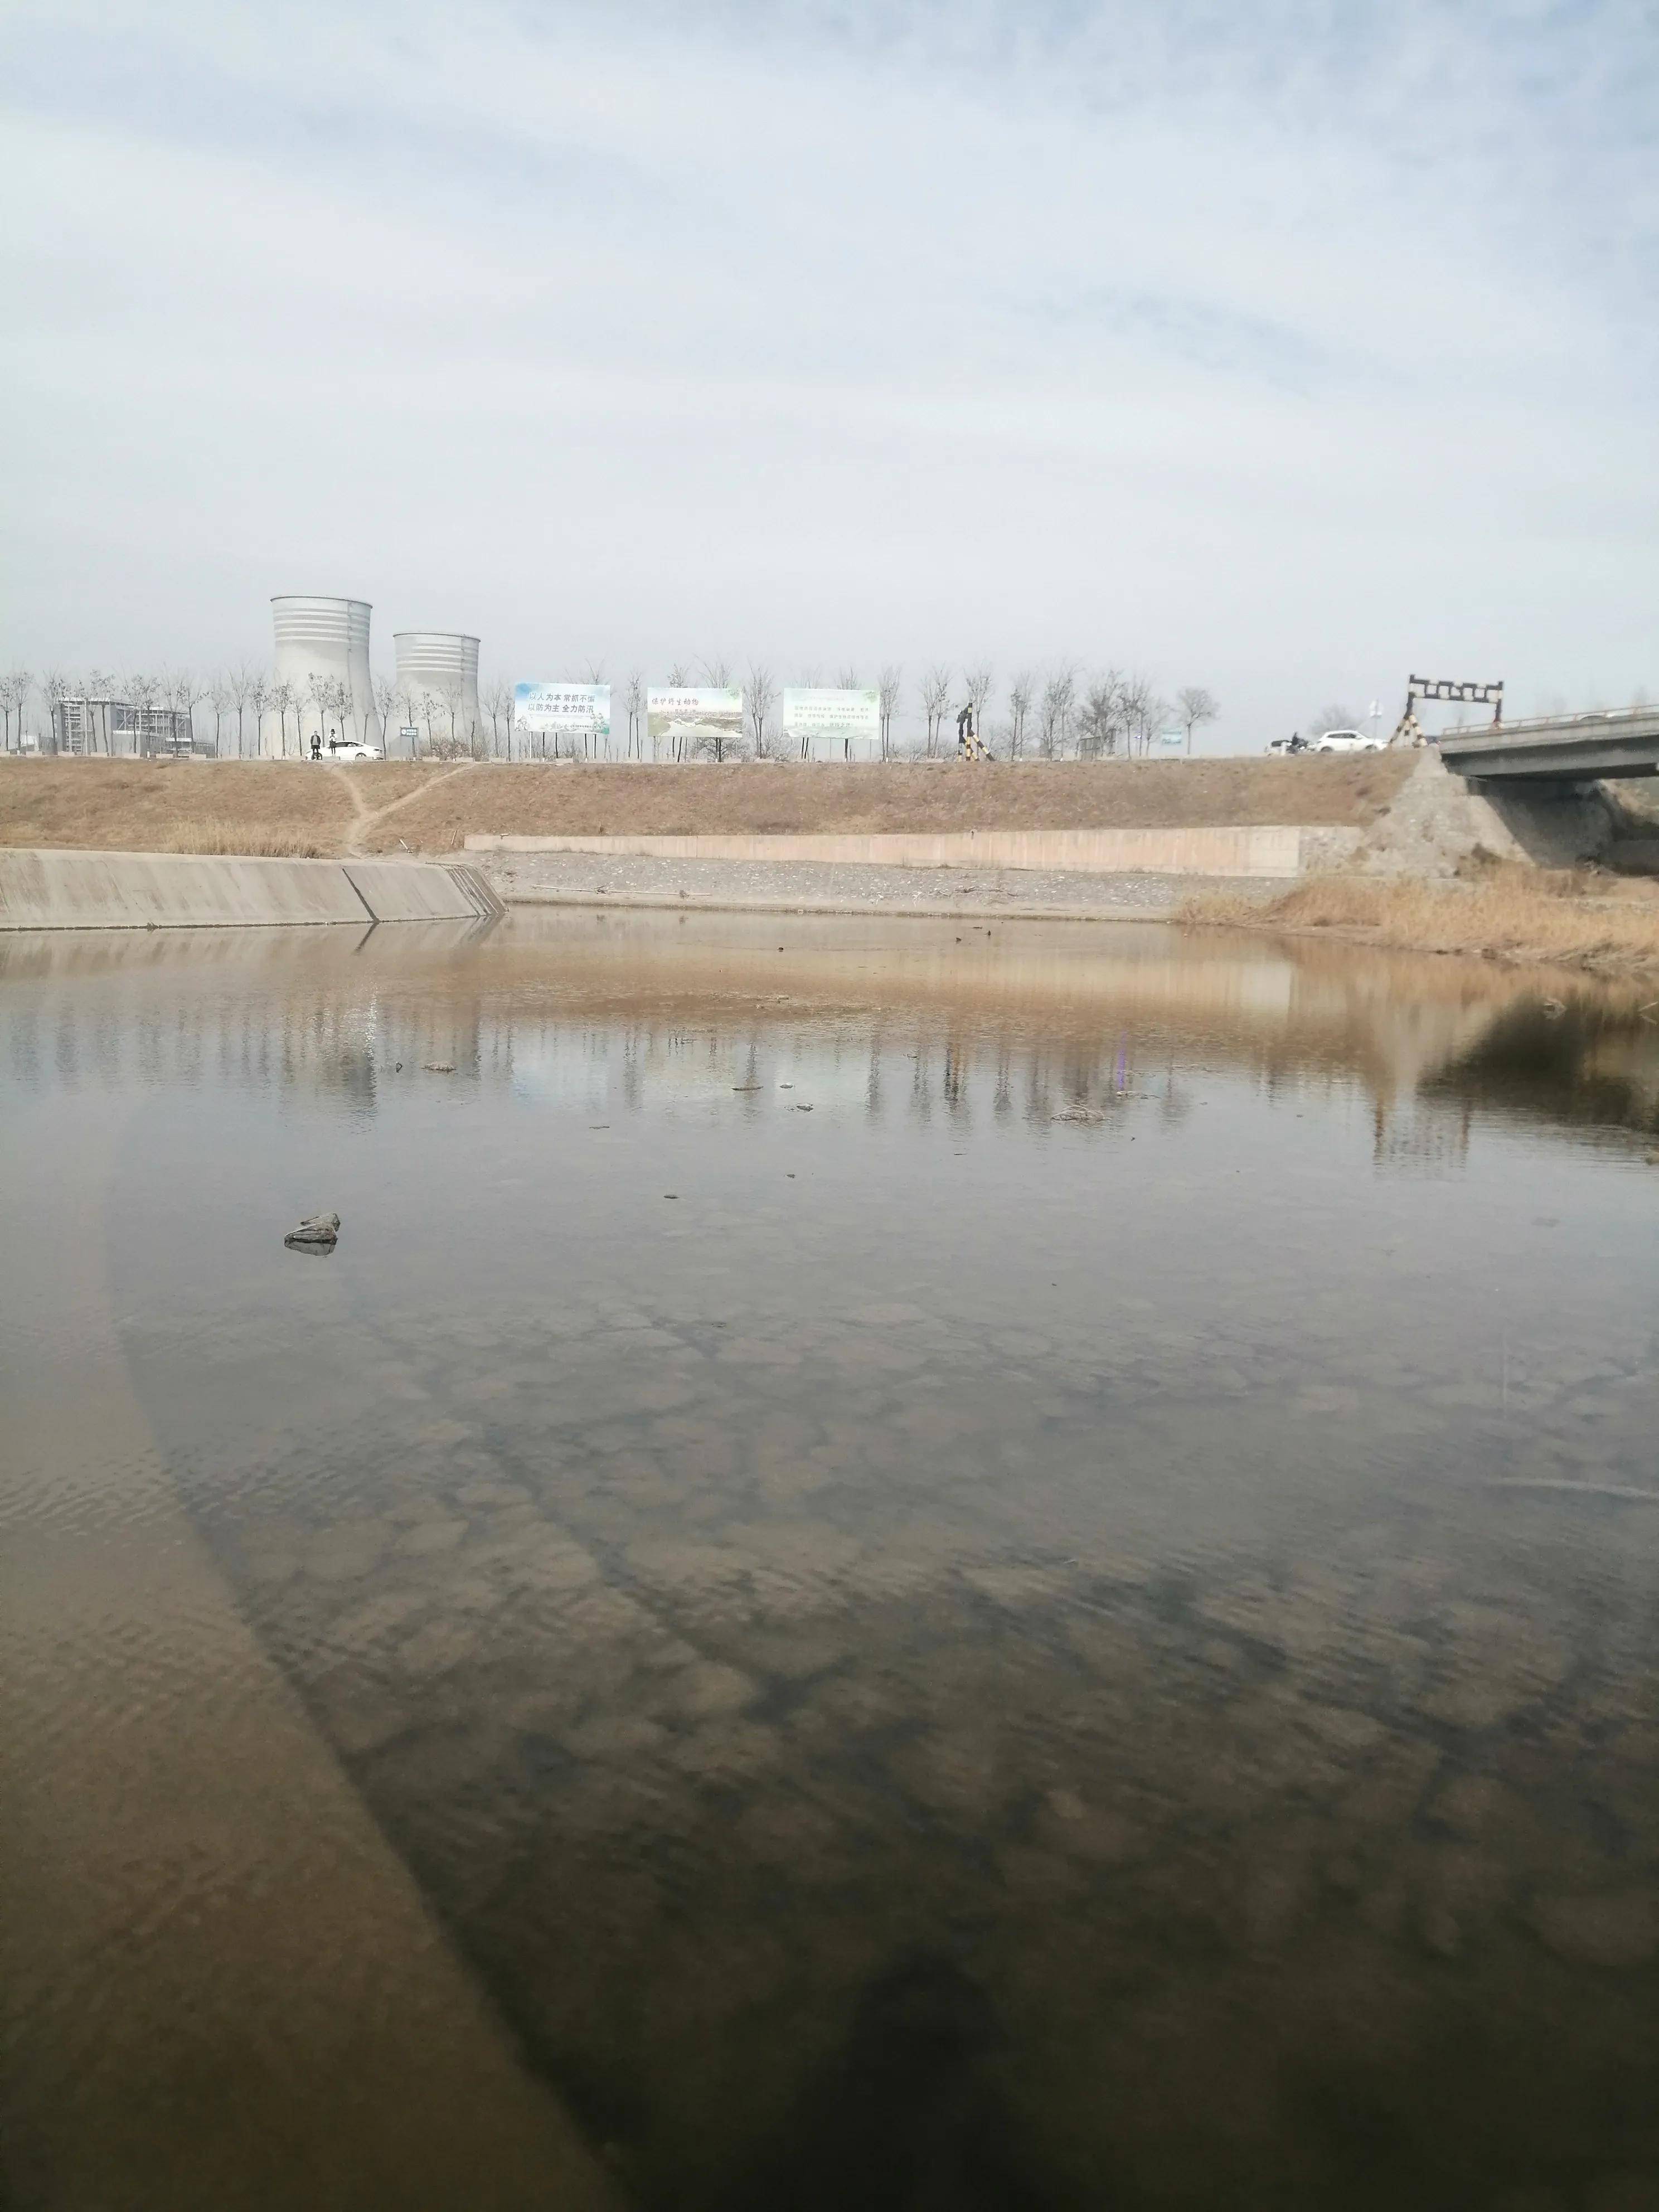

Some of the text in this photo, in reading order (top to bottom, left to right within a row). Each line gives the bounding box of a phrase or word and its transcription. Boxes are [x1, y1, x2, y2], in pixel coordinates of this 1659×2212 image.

[529, 692, 561, 701] 以人为本
[527, 704, 594, 713] 以防为主 全力防汛
